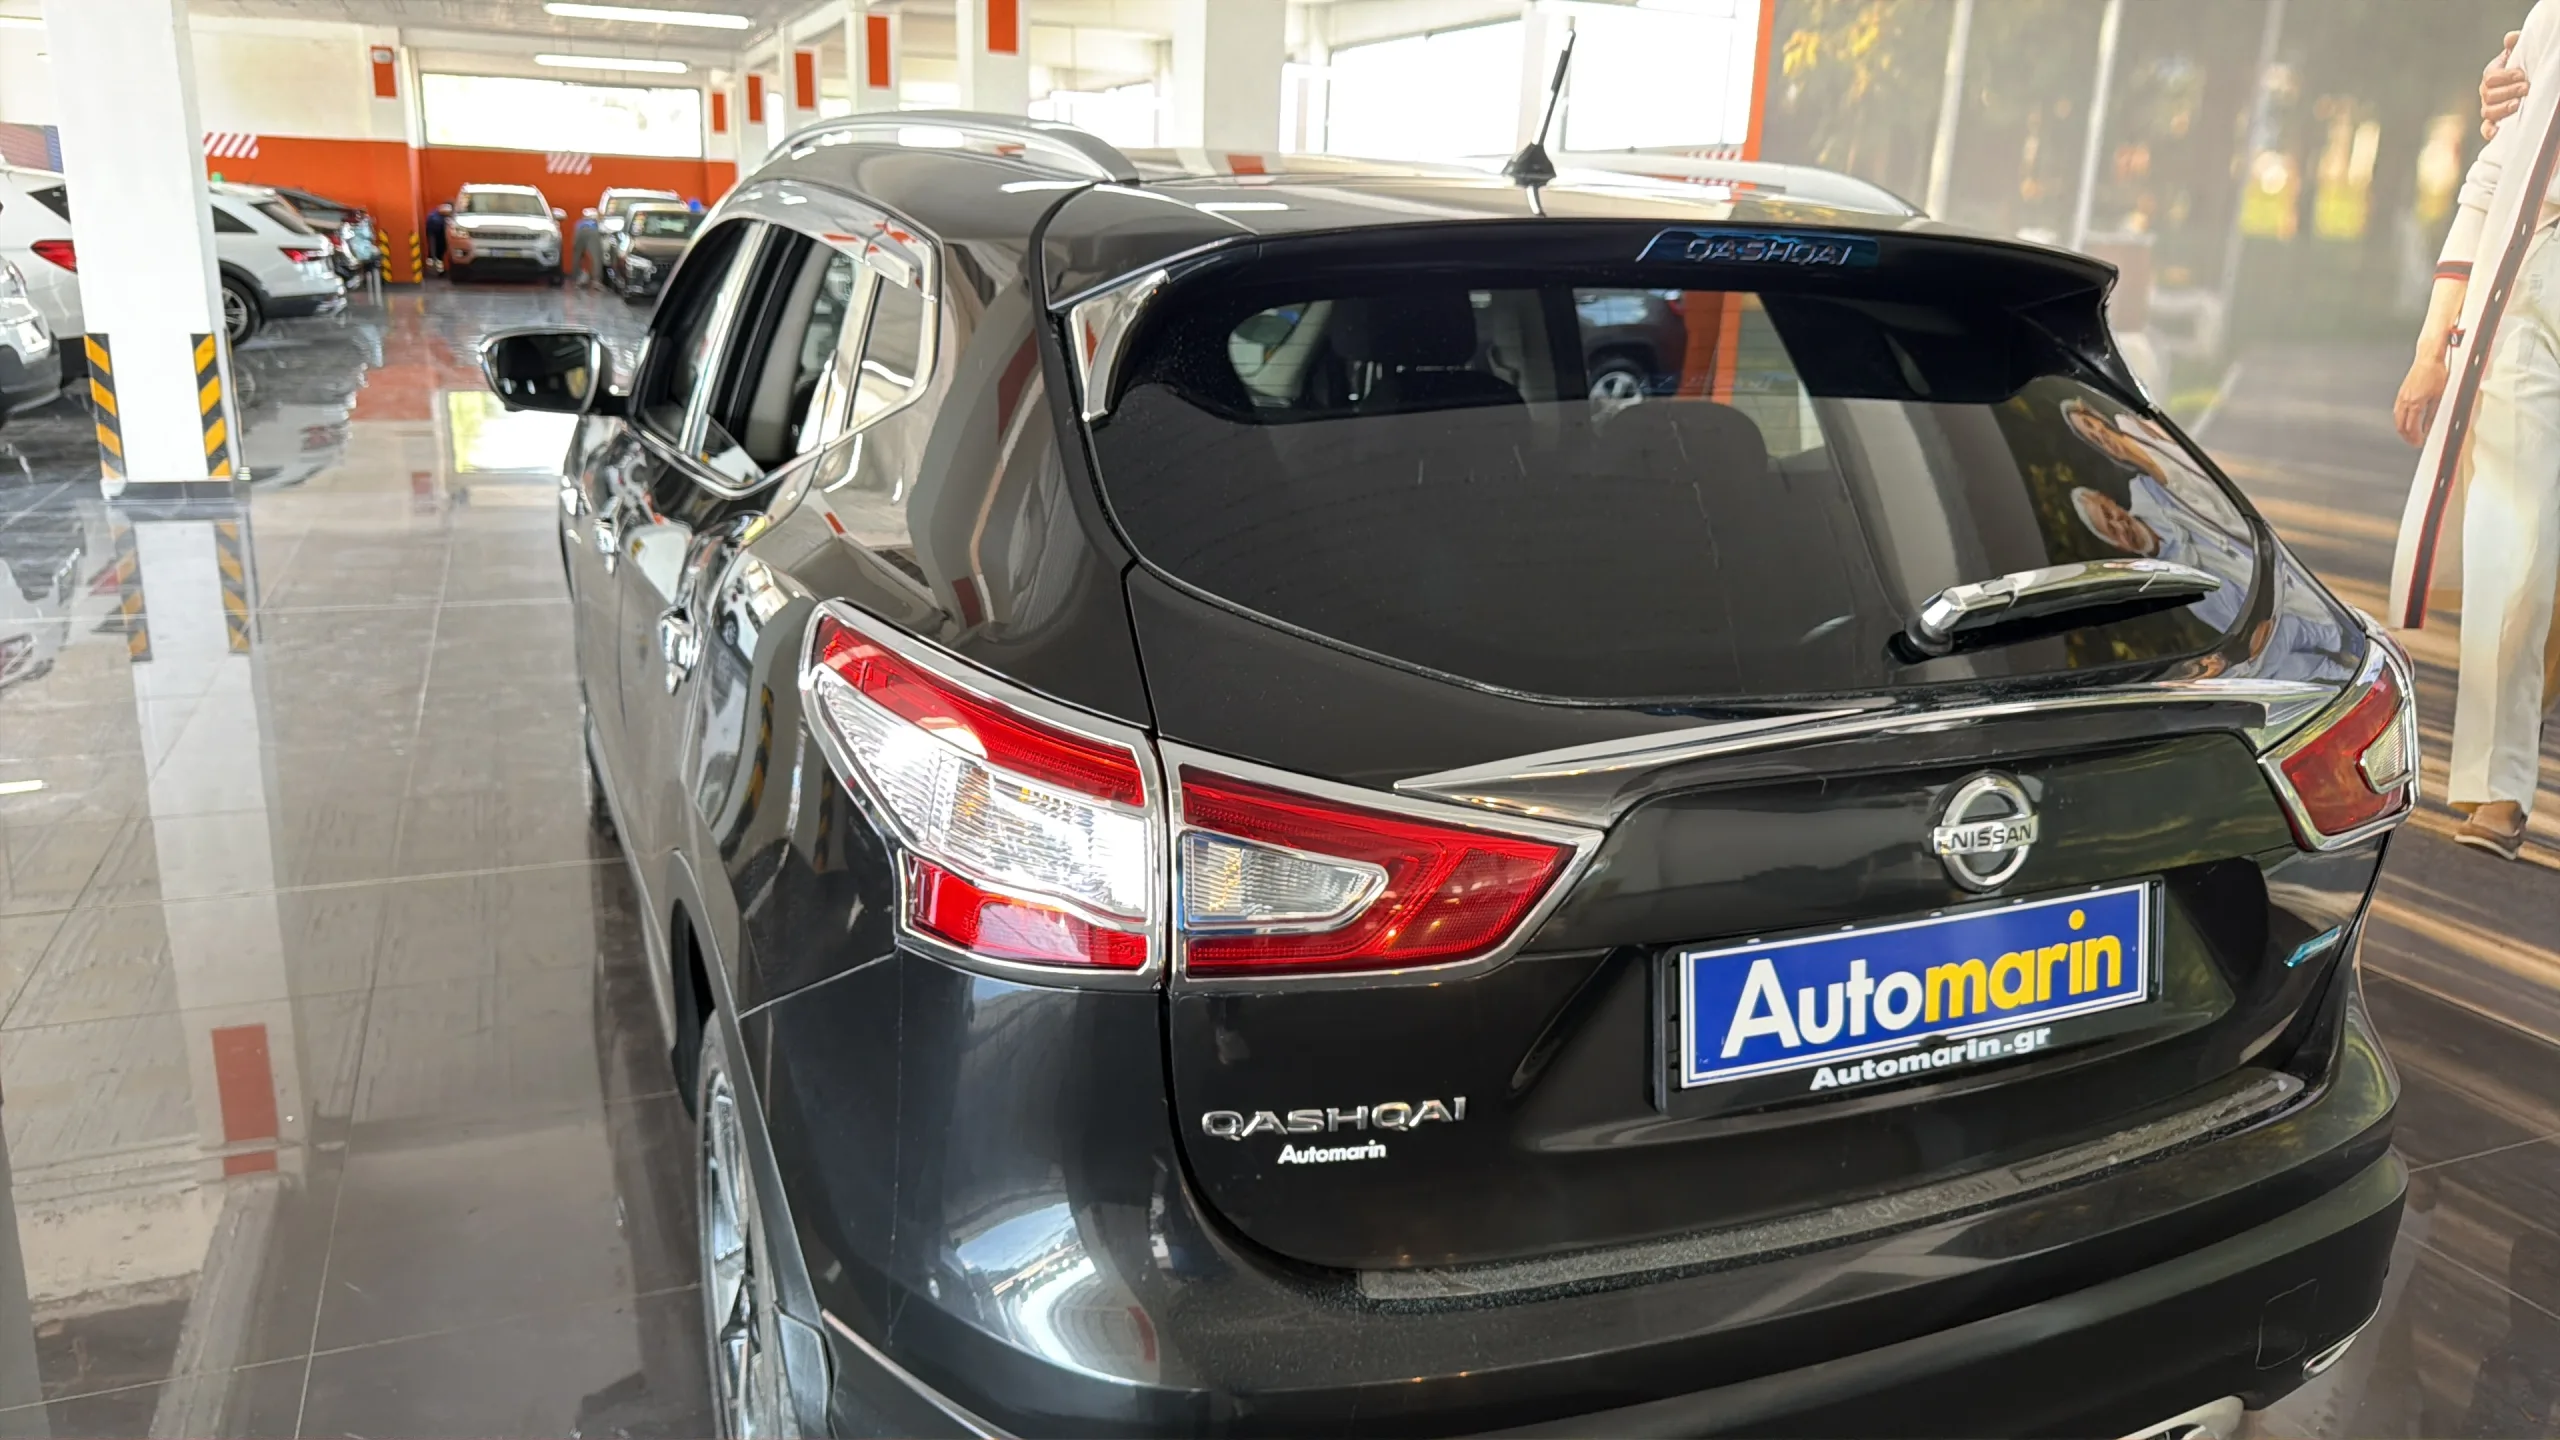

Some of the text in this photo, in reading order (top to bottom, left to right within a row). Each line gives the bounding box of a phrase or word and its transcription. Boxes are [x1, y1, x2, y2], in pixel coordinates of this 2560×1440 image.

[1684, 239, 1852, 266] QASHQAI
[1951, 824, 2032, 849] NISSAN
[1720, 909, 2121, 1058] Automarin
[1809, 1026, 2051, 1091] Automarin.gr
[1202, 1096, 1466, 1141] QASHQAI
[1277, 1139, 1387, 1164] Automarin
